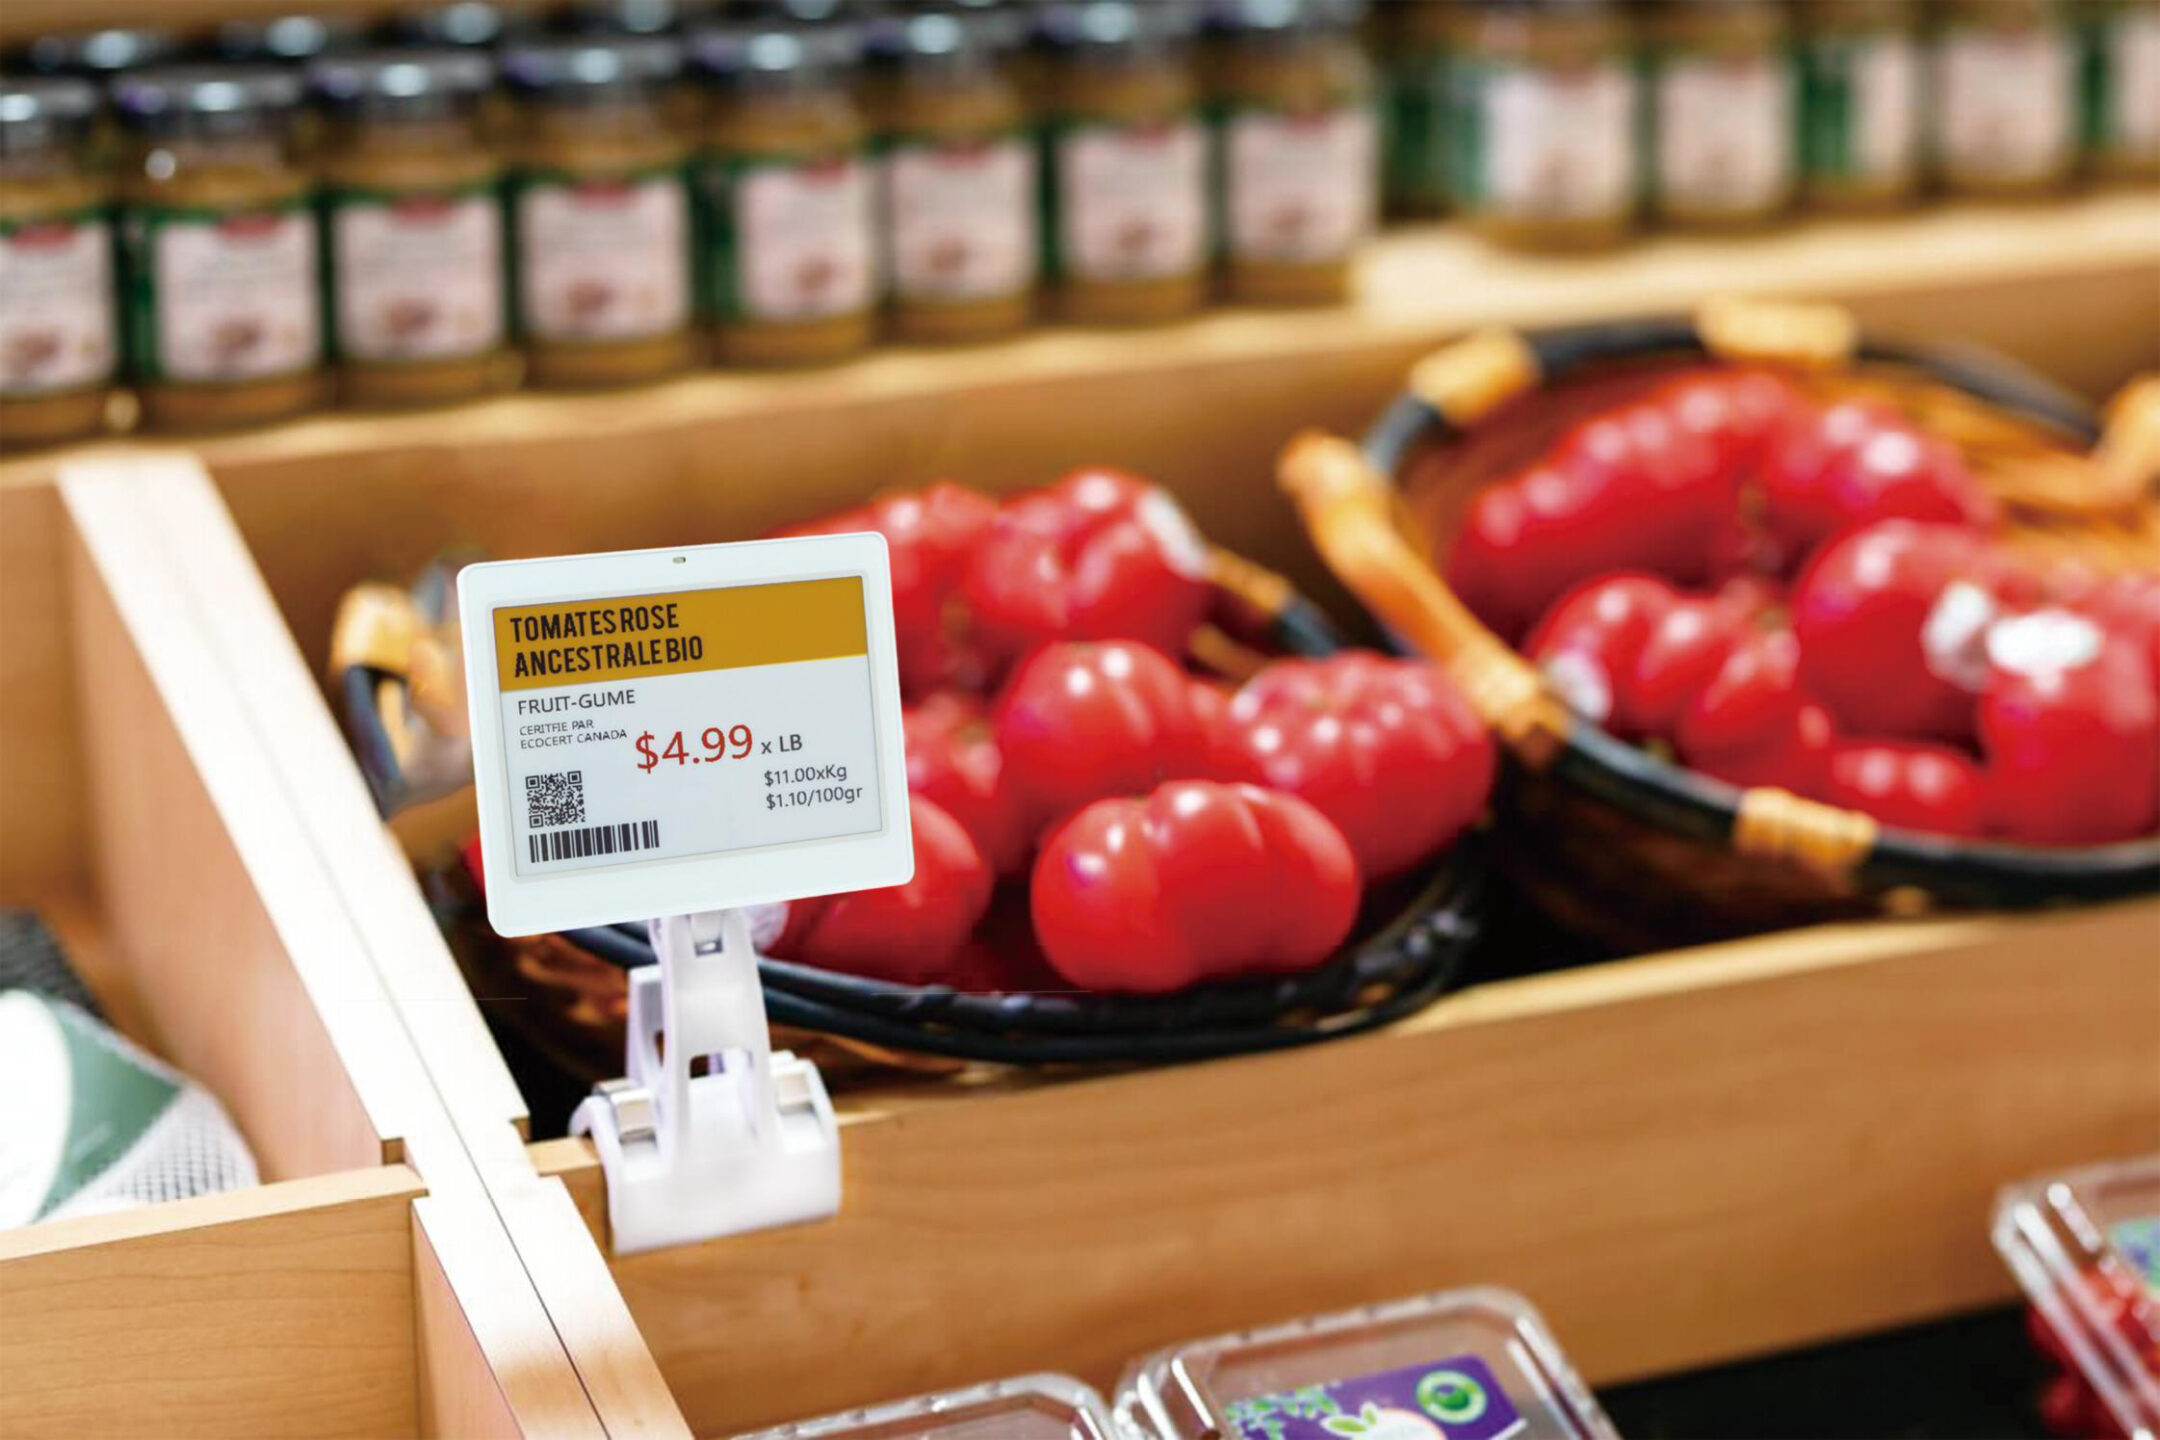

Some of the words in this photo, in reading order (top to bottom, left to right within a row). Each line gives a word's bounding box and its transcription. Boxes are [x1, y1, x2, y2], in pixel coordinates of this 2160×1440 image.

[510, 609, 616, 643] TOMATES
[620, 603, 679, 633] ROSE
[515, 639, 663, 678] ANCESTRALE
[666, 636, 703, 663] BIO
[518, 689, 636, 715] FRUIT-GUME
[572, 719, 594, 731] PAR
[520, 734, 573, 750] ECOCERT
[577, 729, 627, 744] CANADA
[635, 724, 753, 774] $4.99
[760, 740, 772, 754] x
[779, 733, 803, 752] LB
[764, 764, 847, 787] $11.00xKg
[766, 786, 863, 810] $1.10/100gr
